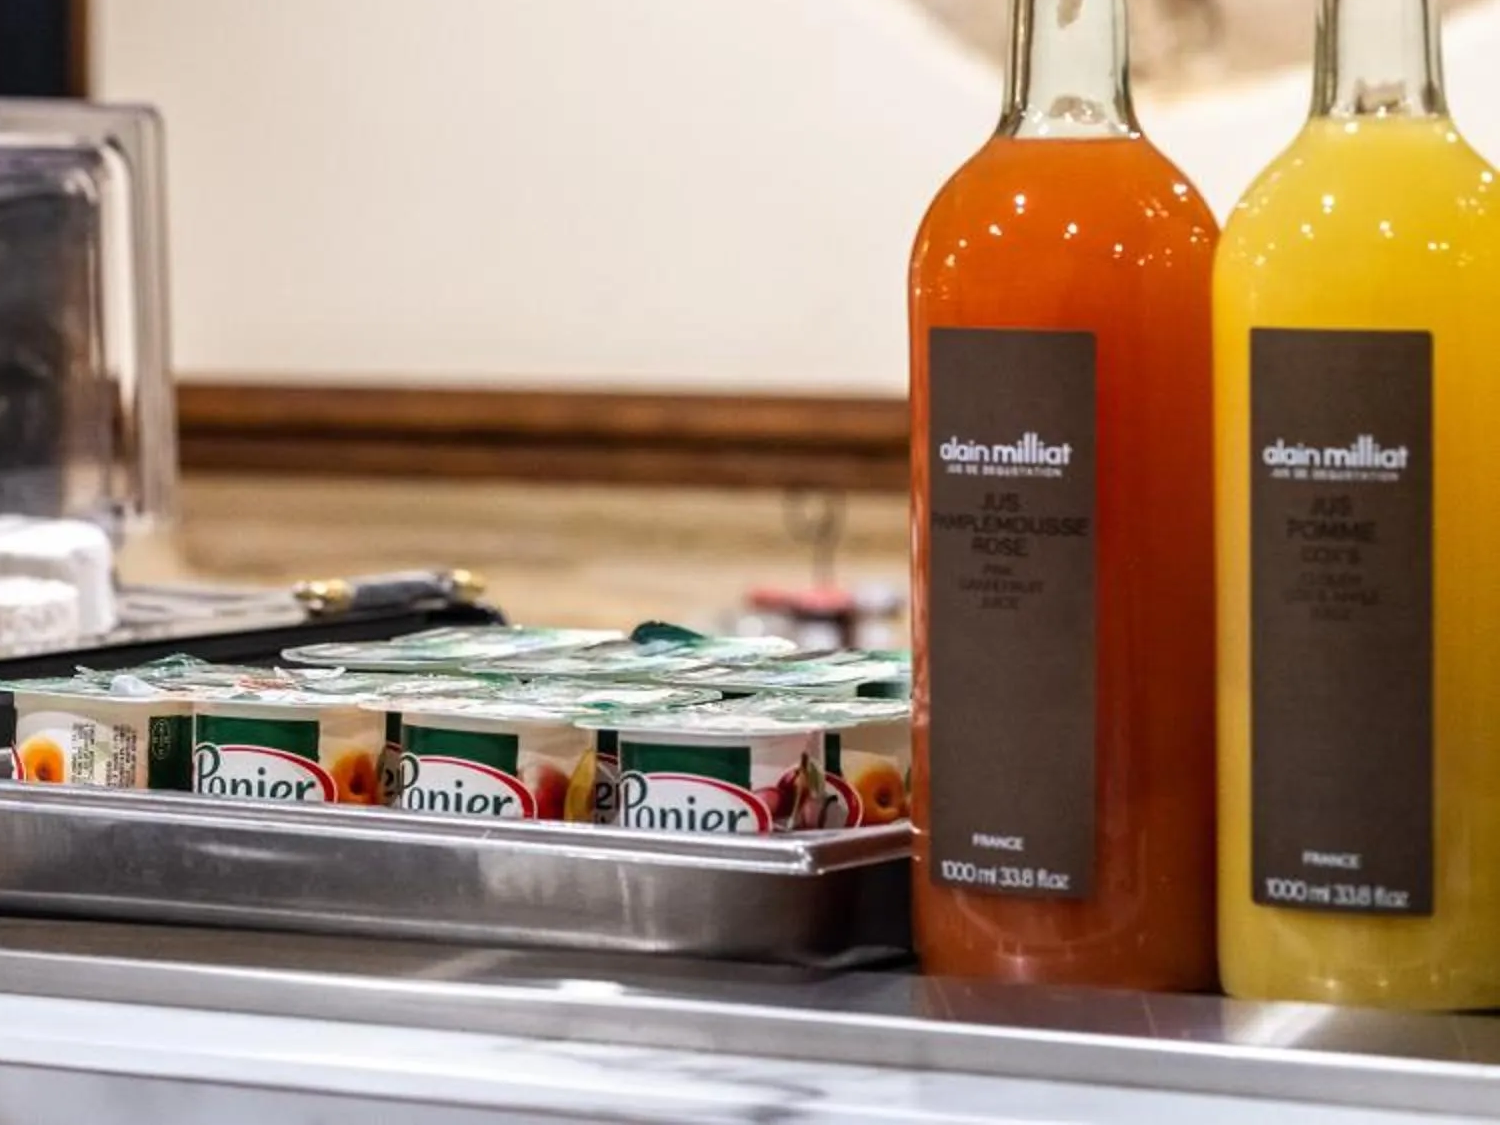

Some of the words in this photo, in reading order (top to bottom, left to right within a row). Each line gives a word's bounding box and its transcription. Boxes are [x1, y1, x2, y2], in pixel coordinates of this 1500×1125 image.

[939, 436, 990, 462] alain
[992, 432, 1072, 465] milliat
[1263, 438, 1321, 466] alain
[1323, 435, 1408, 468] milliat
[981, 492, 1021, 512] JUS
[1310, 495, 1353, 517] JUS
[1286, 518, 1378, 544] POMME
[971, 536, 1029, 557] ROSE
[620, 772, 748, 832] Panier
[971, 832, 1024, 851] FRANCE
[941, 859, 976, 883] 1000
[977, 866, 997, 885] ml
[1302, 850, 1362, 869] FRANCE
[1266, 877, 1308, 902] 1000
